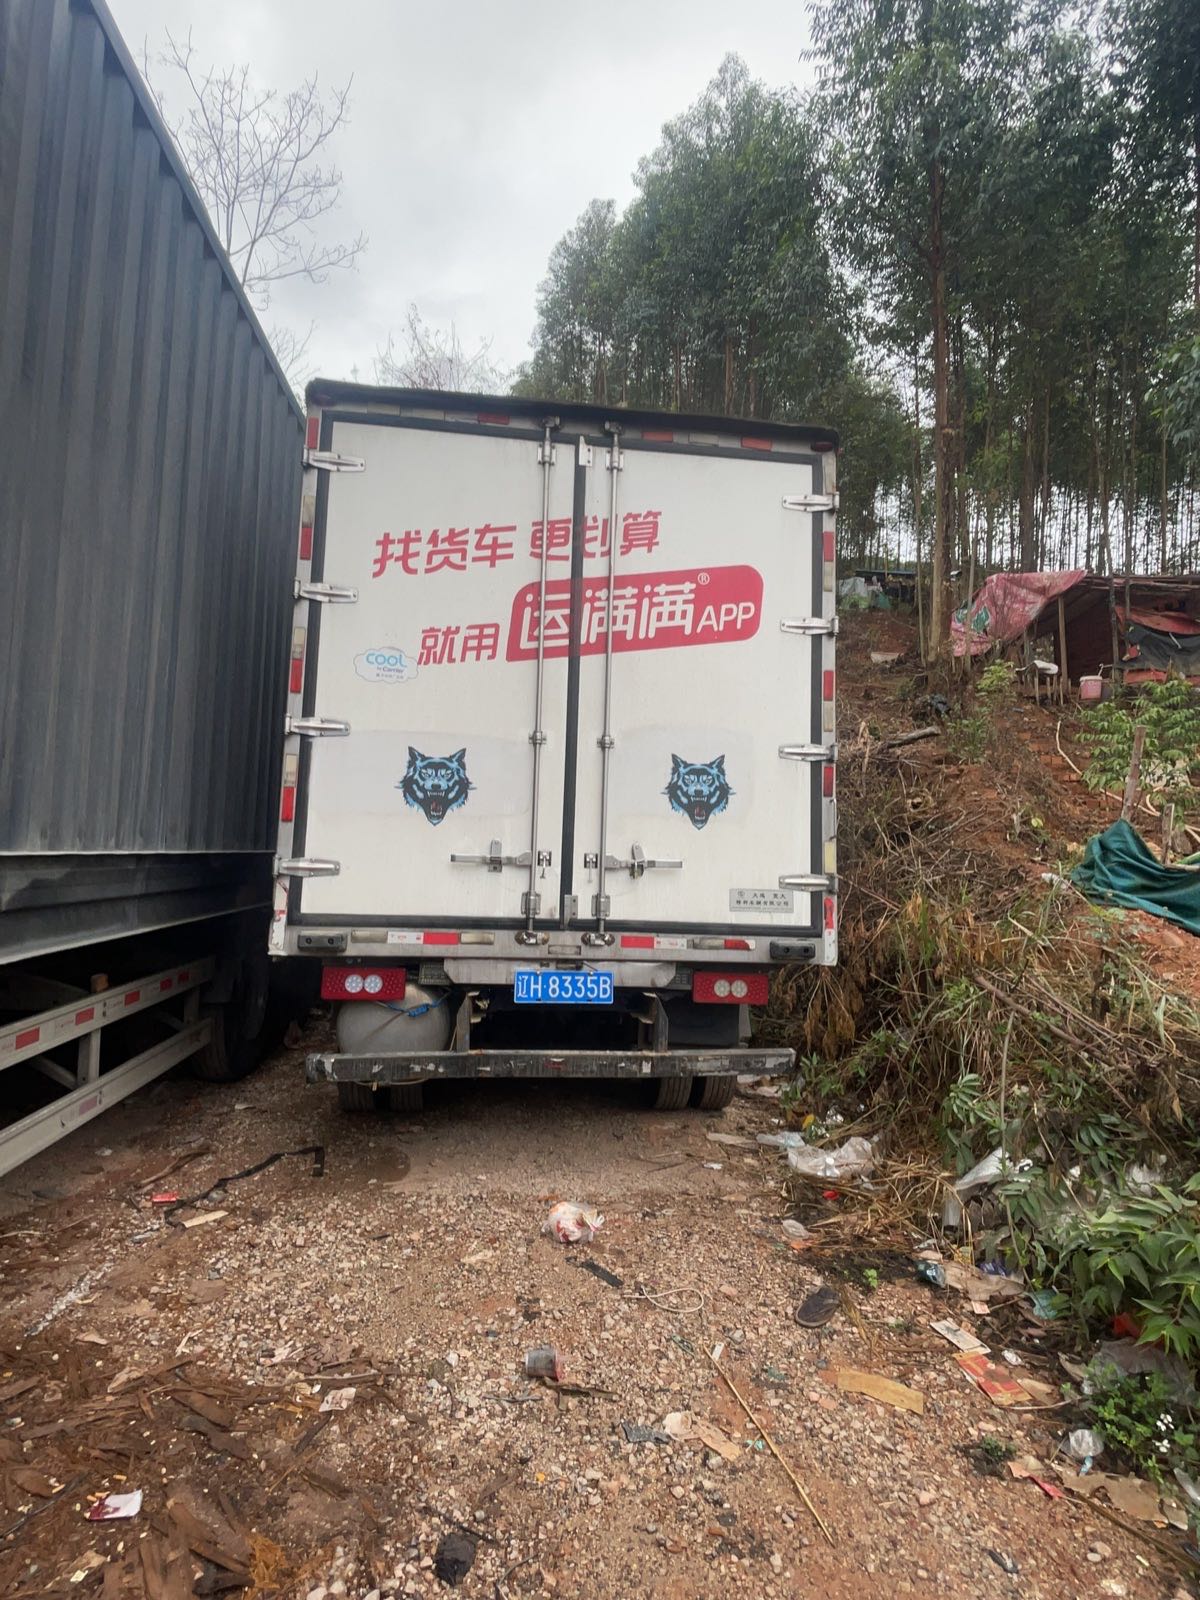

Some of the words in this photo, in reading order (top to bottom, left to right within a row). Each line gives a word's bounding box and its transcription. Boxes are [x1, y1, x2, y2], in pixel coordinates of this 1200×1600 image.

[372, 523, 517, 579] 找货车
[529, 510, 662, 562] 更划算
[417, 622, 500, 666] 就用
[519, 581, 696, 650] 运满满
[696, 601, 755, 633] APP
